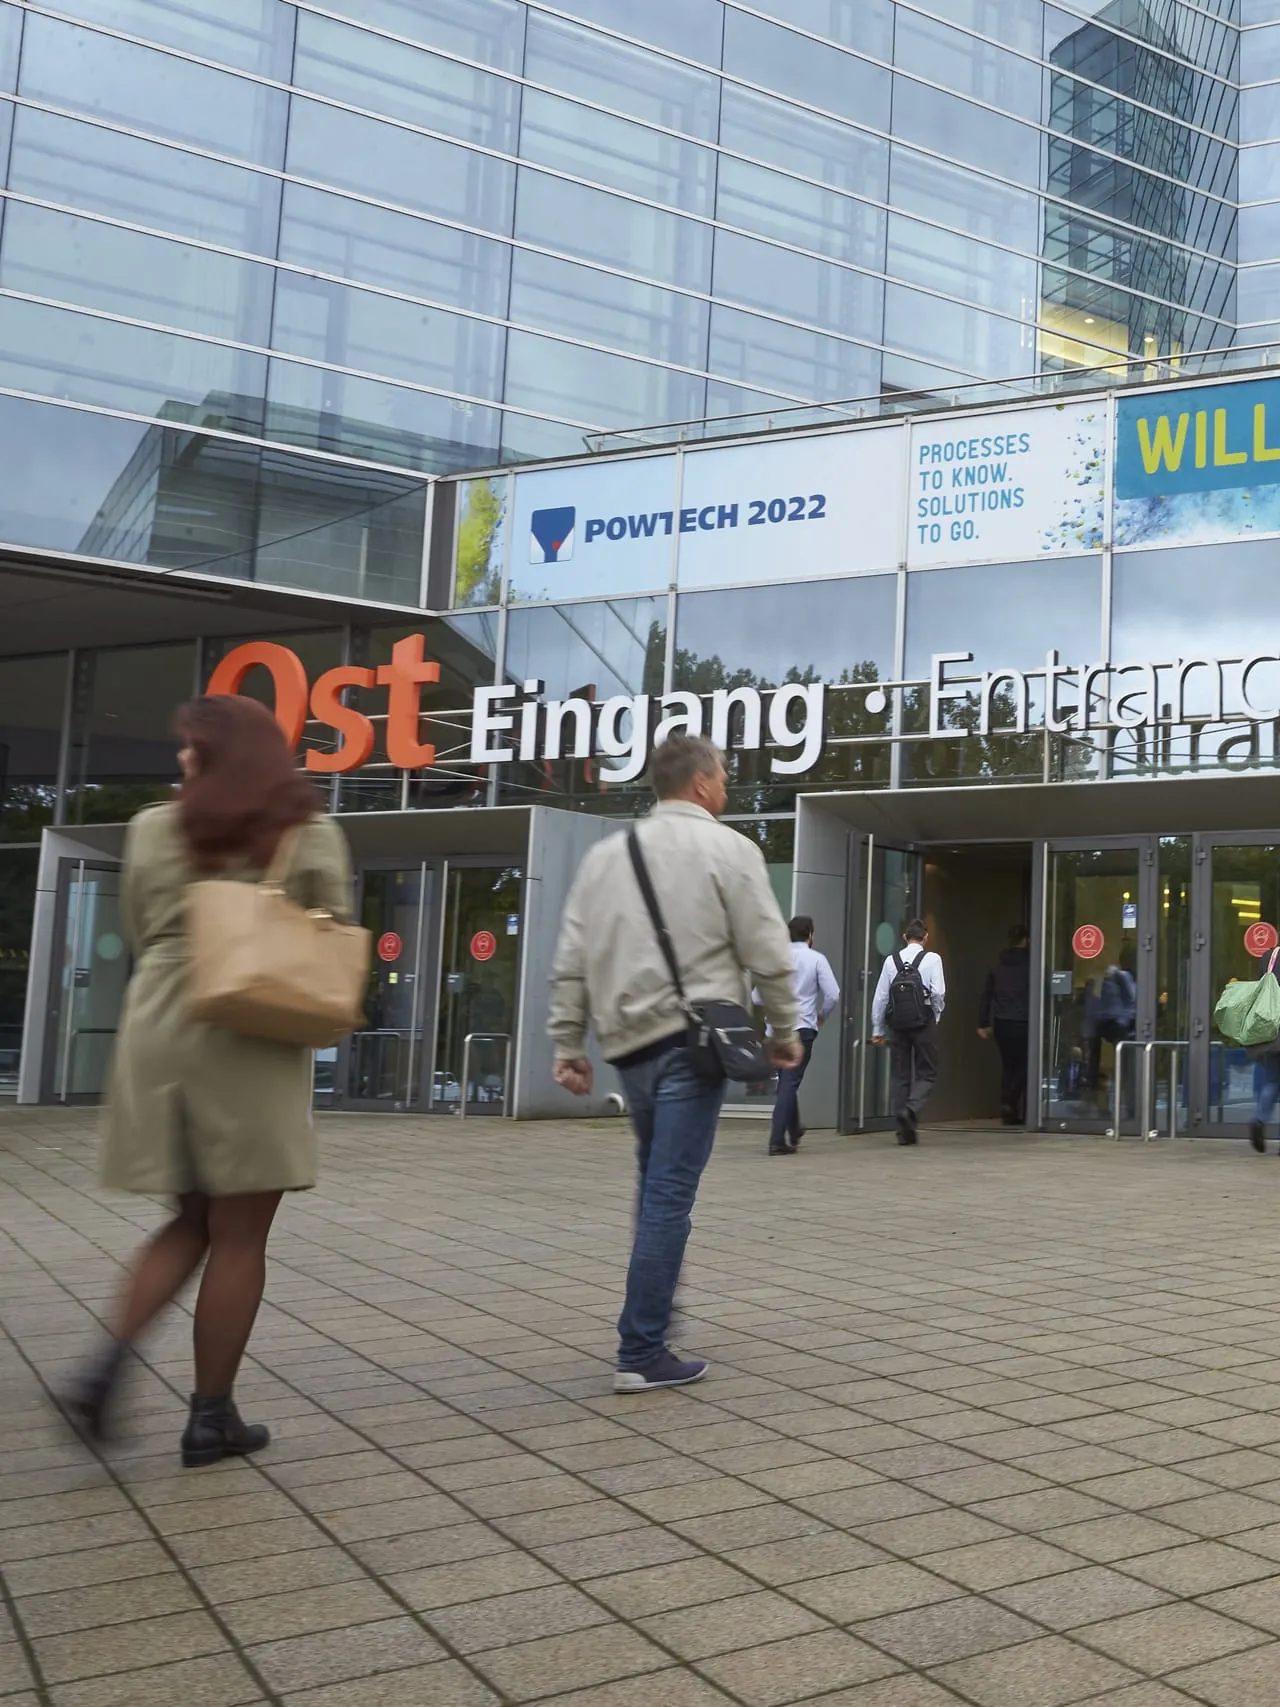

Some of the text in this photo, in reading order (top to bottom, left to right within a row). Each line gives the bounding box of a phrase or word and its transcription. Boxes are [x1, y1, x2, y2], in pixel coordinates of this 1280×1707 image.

[919, 432, 1031, 465] PROCESSES
[919, 461, 1013, 491] TO KNOW.
[584, 494, 827, 543] POWTECH 2022
[917, 487, 1025, 518] SOLUTIONS
[917, 519, 980, 545] TO GO.
[470, 679, 828, 783] Eingang
